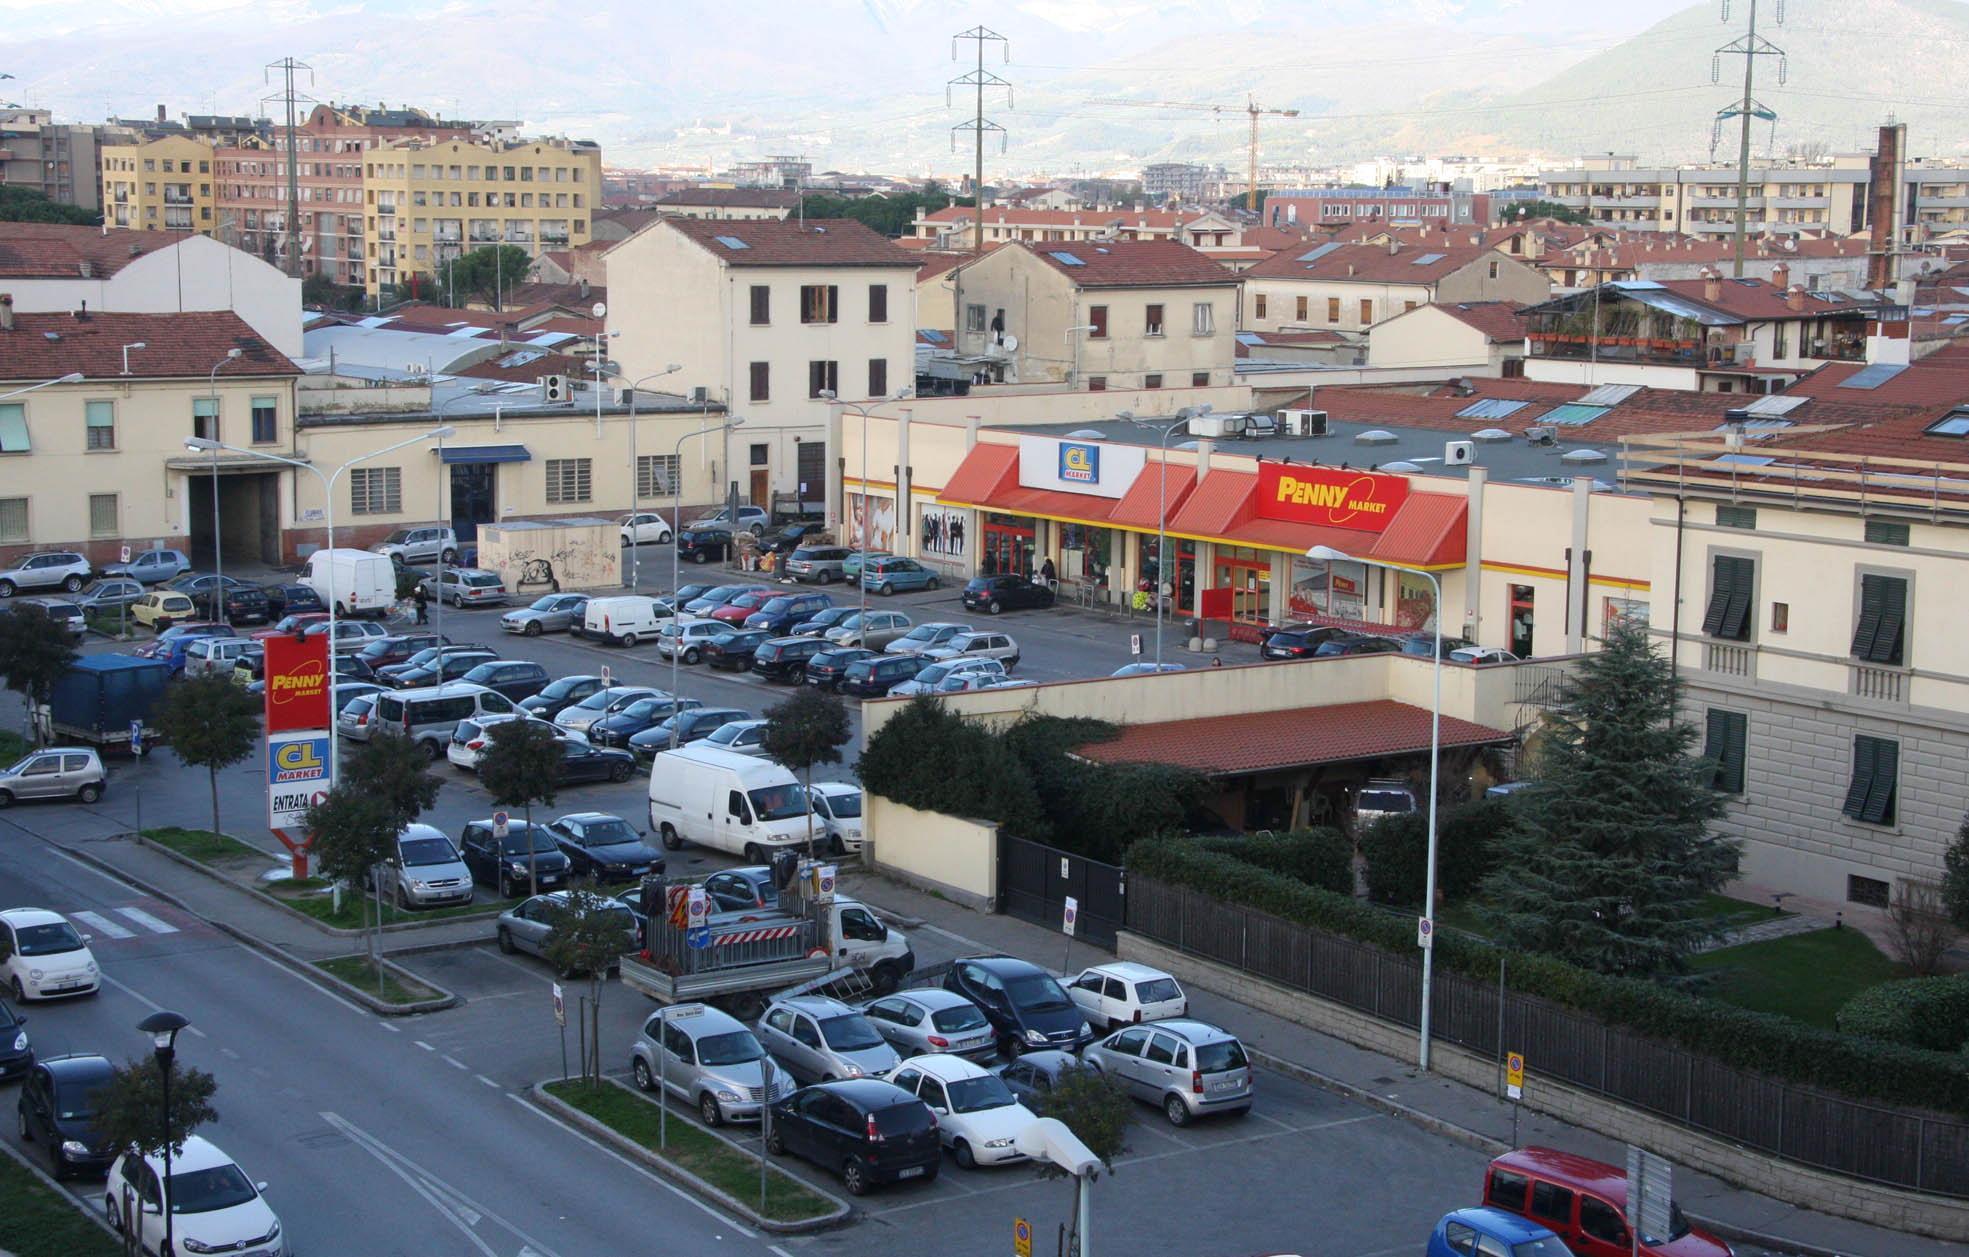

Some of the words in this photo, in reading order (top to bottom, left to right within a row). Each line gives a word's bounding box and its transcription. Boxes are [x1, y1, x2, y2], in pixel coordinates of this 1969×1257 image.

[1065, 447, 1091, 472] CL
[1277, 475, 1349, 508] PENNY
[1348, 500, 1387, 513] MARKET
[272, 674, 325, 690] PENNY
[276, 741, 323, 771] CL
[277, 767, 323, 782] MARKET
[273, 793, 309, 811] ENTRATA
